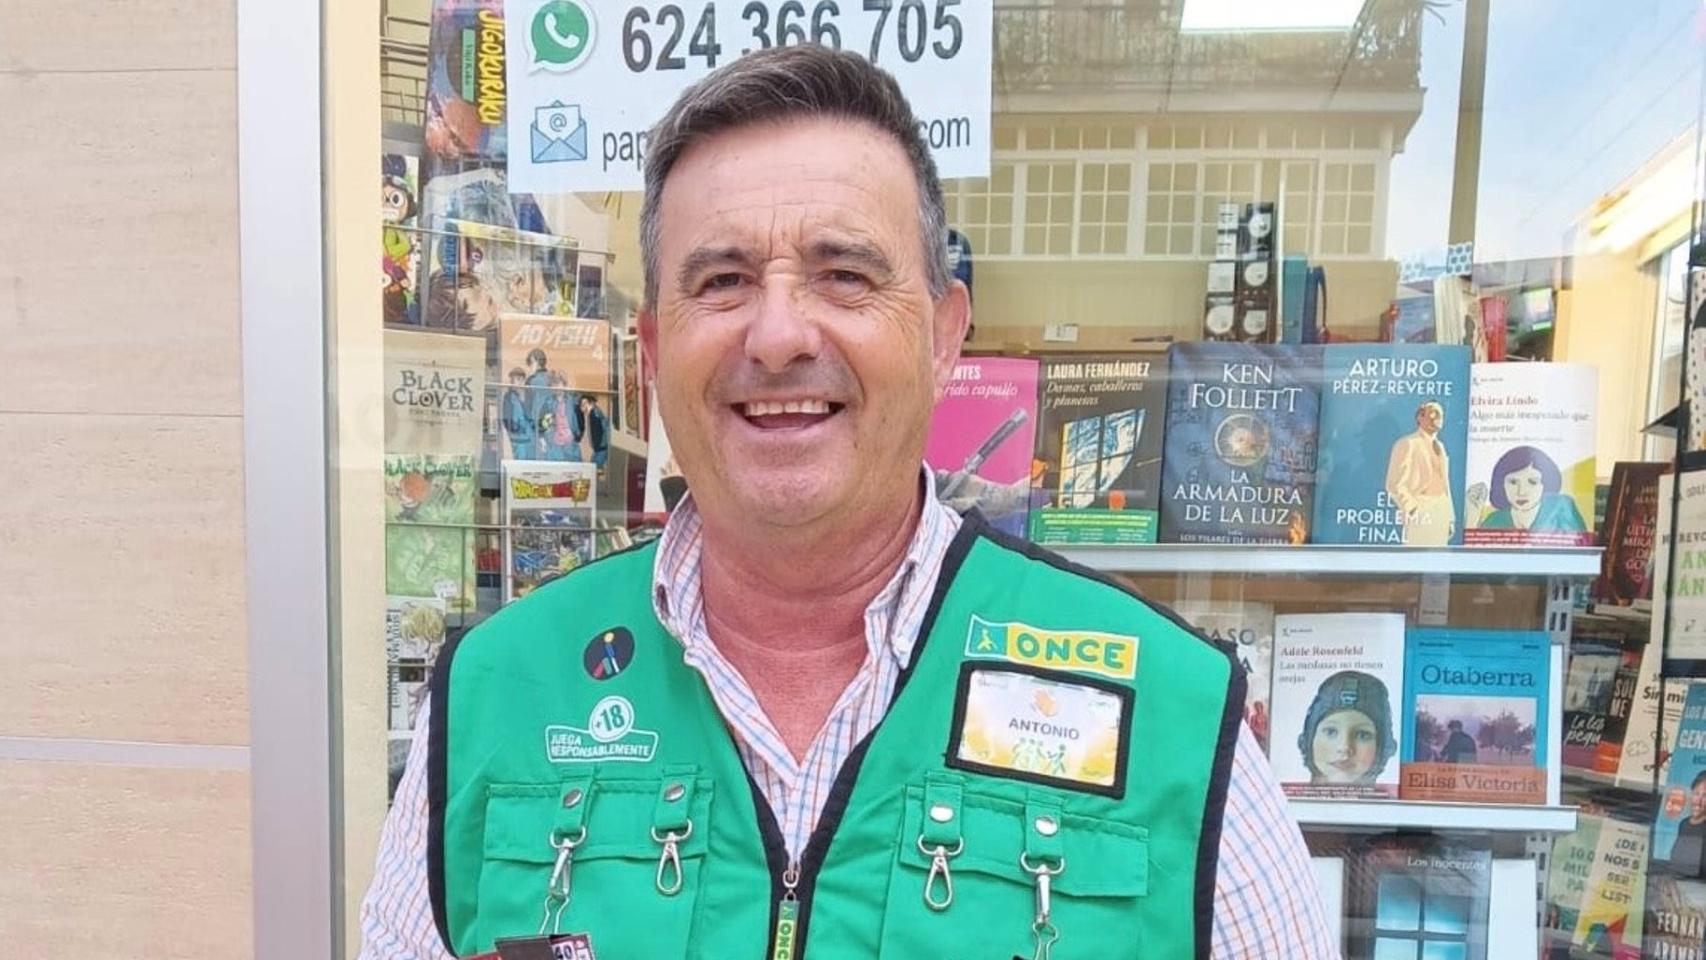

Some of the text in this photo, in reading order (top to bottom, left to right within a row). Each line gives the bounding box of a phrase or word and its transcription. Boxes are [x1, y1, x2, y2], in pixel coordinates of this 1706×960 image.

[622, 3, 721, 73] 624
[862, 0, 963, 63] 705
[478, 9, 505, 124] JIGOKURAKU
[1048, 361, 1150, 379] LAURA FERNÁNDEZ
[1222, 363, 1274, 385] KEN
[1349, 358, 1438, 378] ARTURO
[401, 370, 473, 394] BLACK
[1332, 378, 1453, 396] PÉREZ-REVERTE
[392, 388, 474, 412] CLOVER
[1190, 383, 1302, 413] FOLLETT
[1471, 396, 1538, 406] Elvira Lindo
[1230, 470, 1249, 484] LA
[1172, 484, 1303, 505] ARMADURA
[1377, 491, 1397, 507] EL
[1185, 504, 1289, 525] DE LA LUZ
[1336, 508, 1432, 525] PROBLEMA
[1359, 526, 1408, 543] FINAL
[1017, 632, 1127, 669] ONCE
[1312, 646, 1364, 656] Rosenfeld
[1421, 665, 1535, 688] Otaberra
[1008, 718, 1080, 740] ANTONIO
[551, 734, 582, 745] JUEGA
[551, 744, 650, 757] RESPONSABLEMENTE
[1409, 773, 1539, 792] Elisa Victoria
